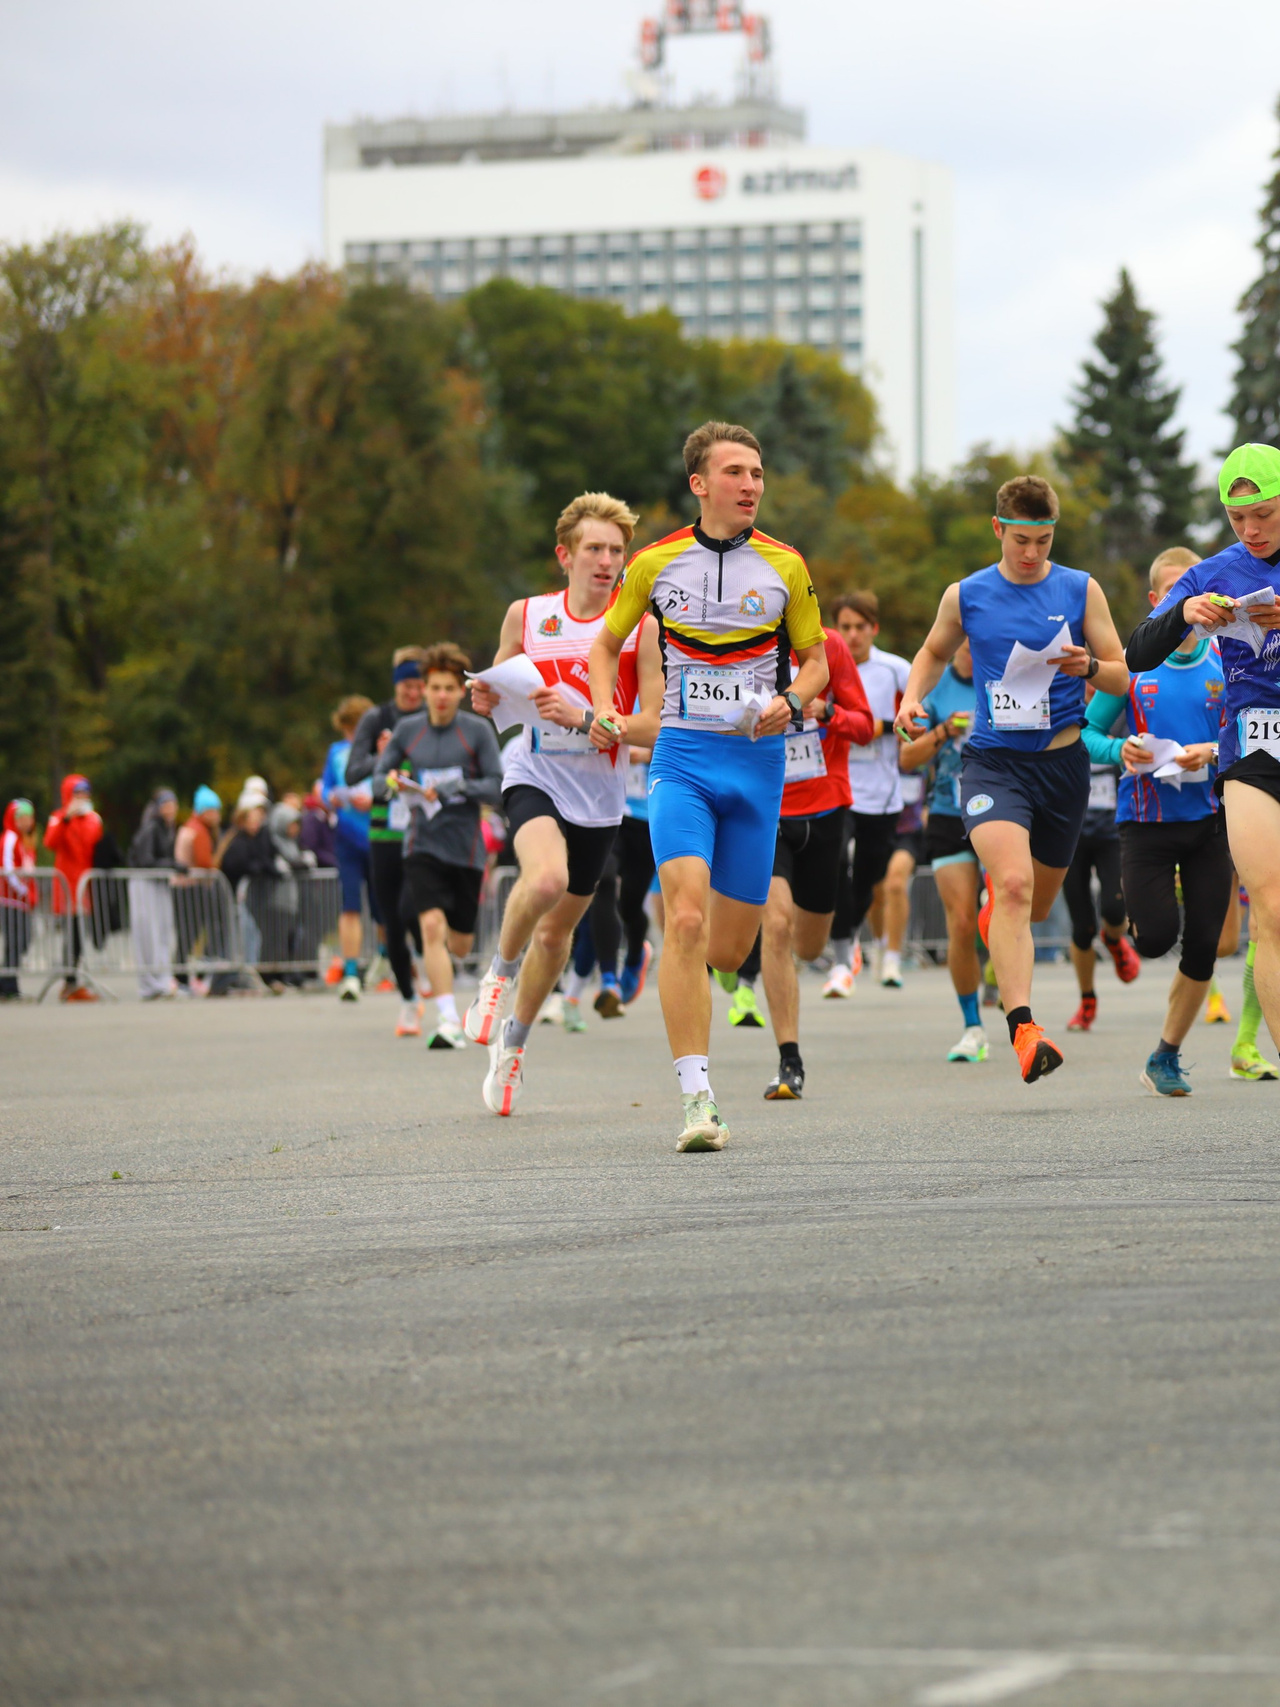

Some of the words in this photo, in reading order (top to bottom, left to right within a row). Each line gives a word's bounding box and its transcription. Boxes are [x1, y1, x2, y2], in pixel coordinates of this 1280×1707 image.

[743, 164, 857, 192] azimut
[569, 662, 590, 686] Ru
[688, 681, 741, 702] 236.1
[785, 745, 811, 762] 2.1
